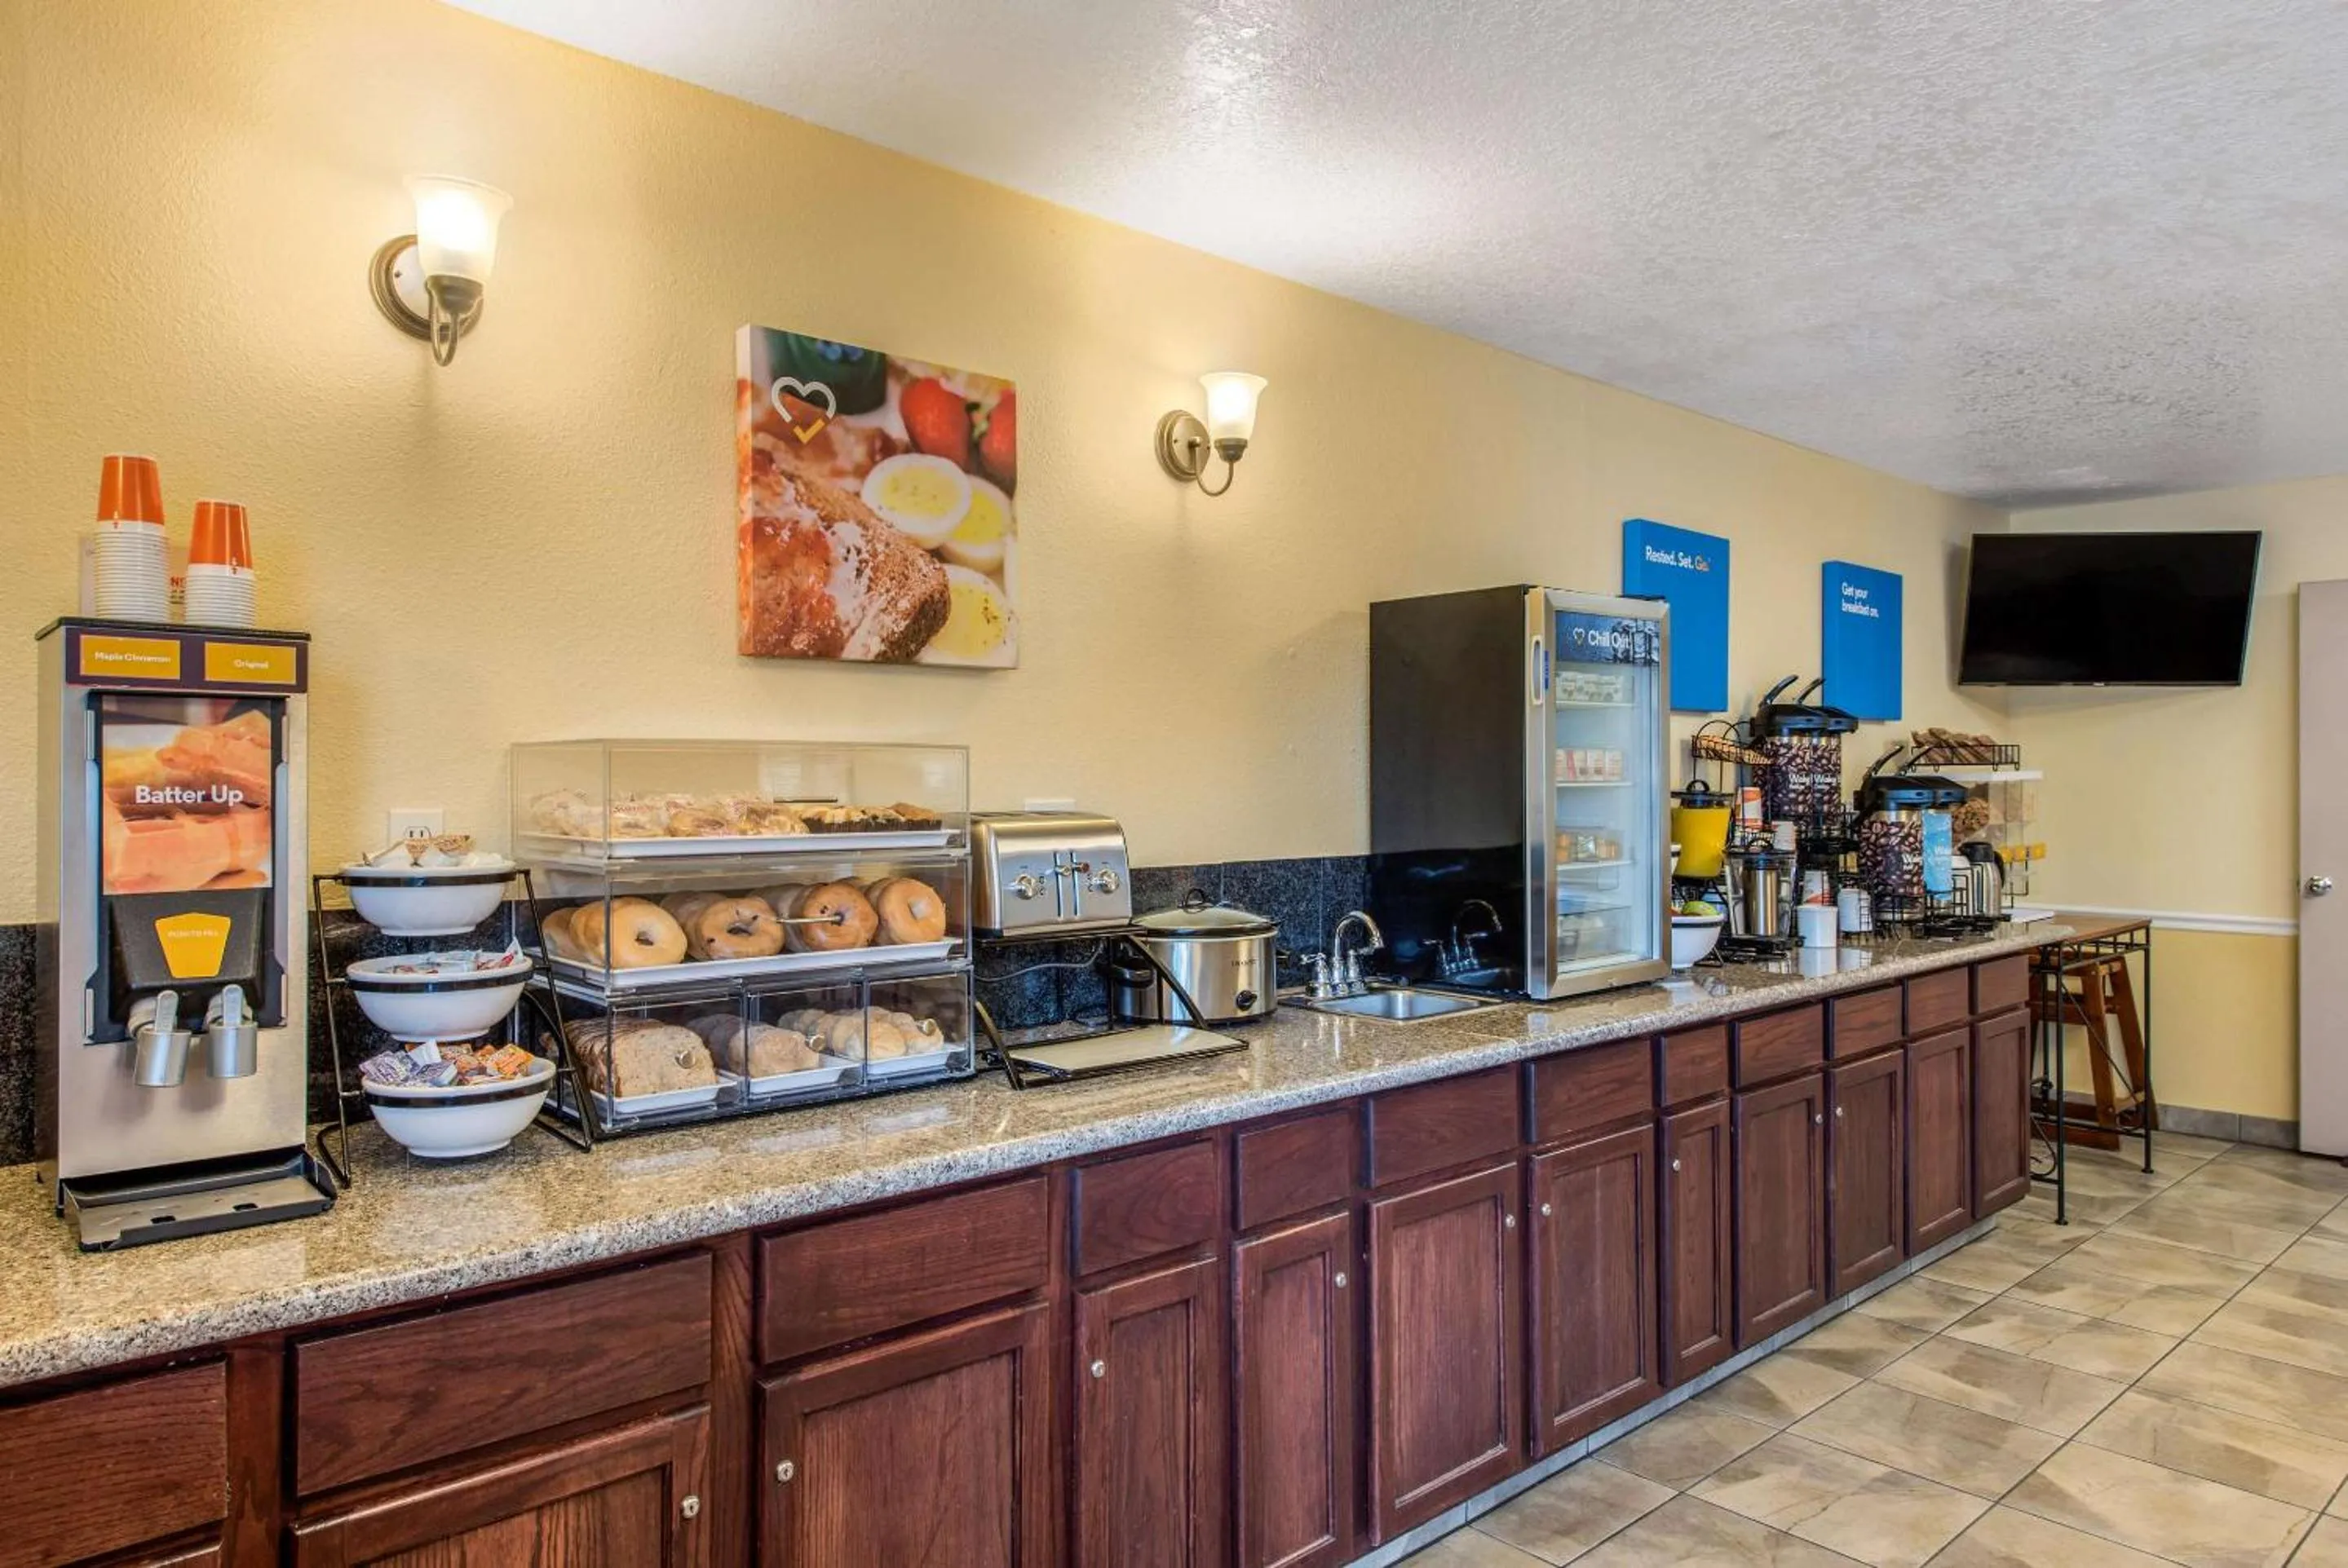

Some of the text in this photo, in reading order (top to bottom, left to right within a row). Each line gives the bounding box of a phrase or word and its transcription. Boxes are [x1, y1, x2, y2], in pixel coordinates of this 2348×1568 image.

[1645, 545, 1678, 566] Rested.
[1678, 551, 1695, 569] Set.
[1842, 581, 1868, 601] Get your
[1588, 629, 1611, 647] Chill
[94, 651, 124, 663] Maple
[135, 784, 244, 806] Batter Up
